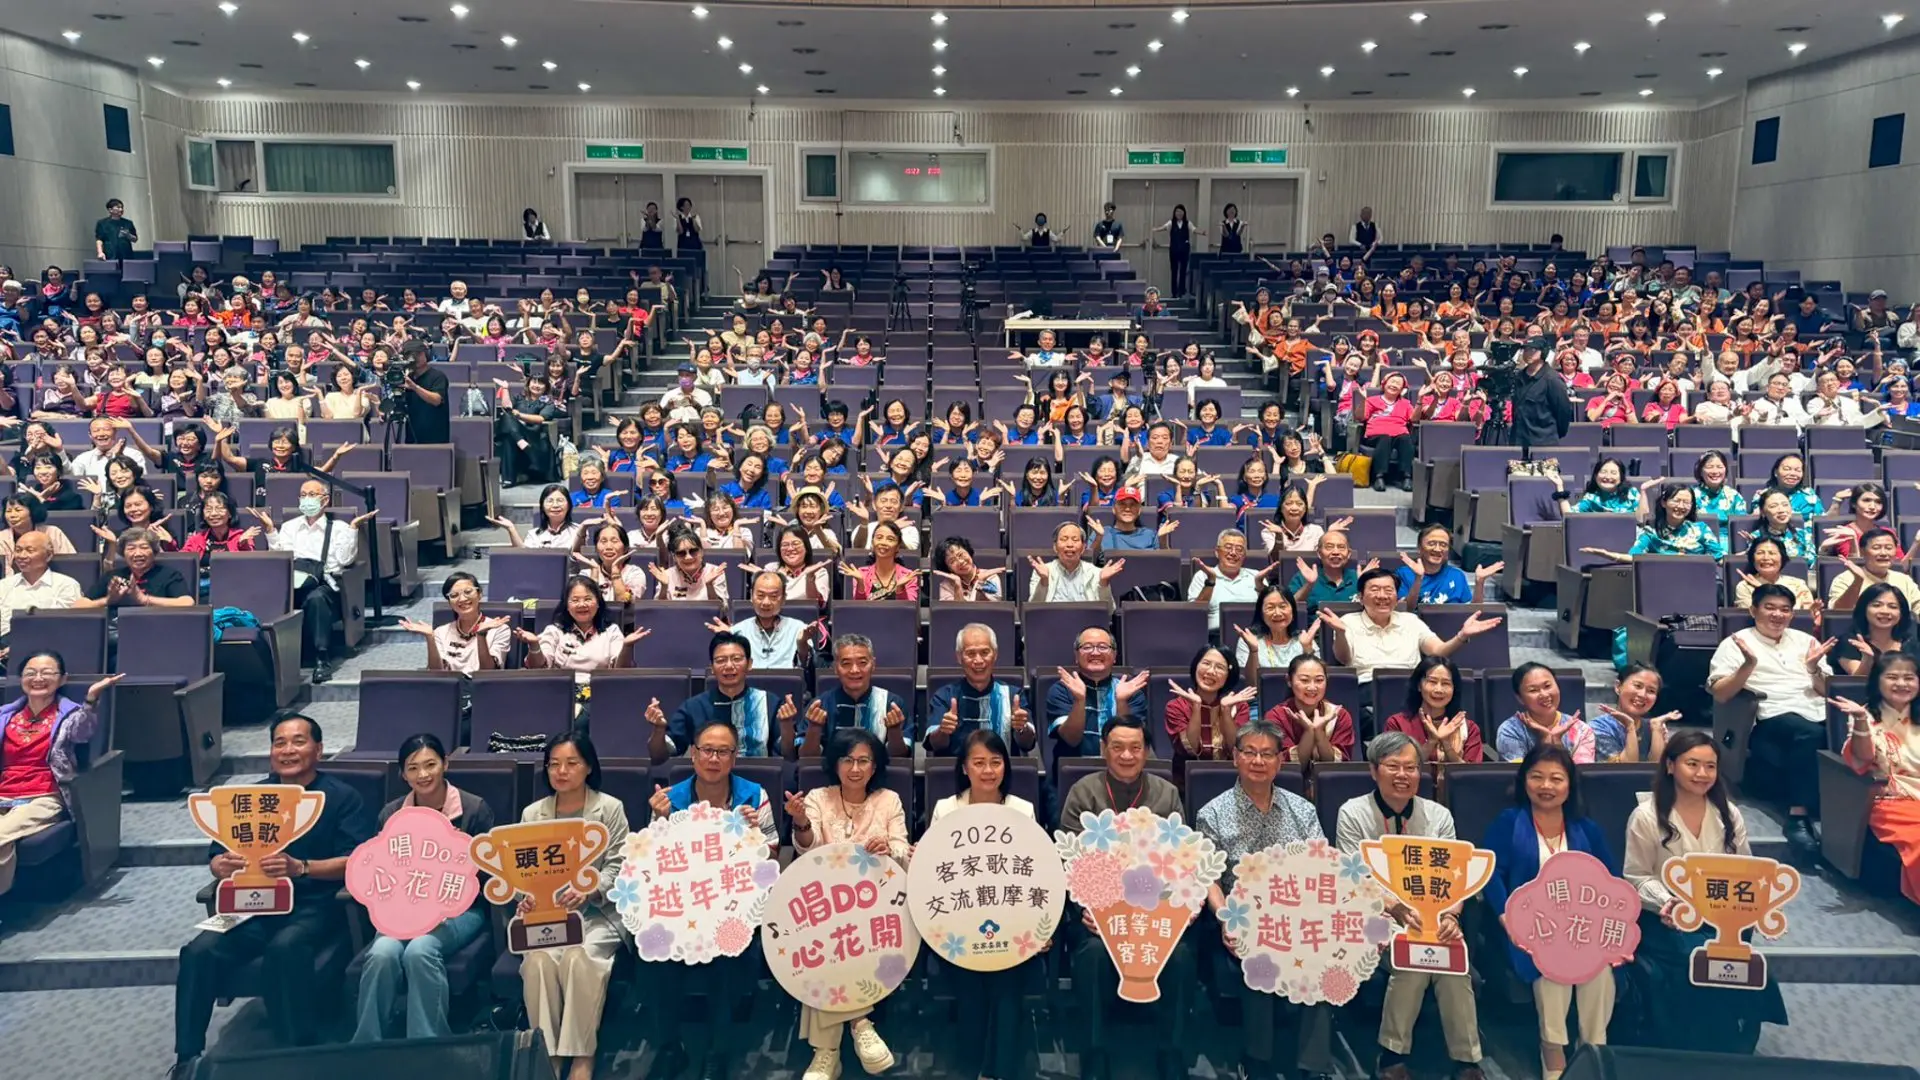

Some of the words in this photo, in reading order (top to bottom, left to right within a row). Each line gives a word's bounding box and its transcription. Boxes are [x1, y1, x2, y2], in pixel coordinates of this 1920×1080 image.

[231, 822, 280, 843] 唱歌
[389, 833, 412, 859] 唱
[421, 840, 451, 862] Do
[951, 825, 1013, 849] 2026
[515, 844, 566, 869] 頭名
[656, 832, 723, 876] 越唱
[936, 853, 1034, 884] 客家歌謠
[367, 867, 466, 903] 心花開
[648, 861, 754, 919] 越年輕
[1268, 873, 1337, 907] 越唱
[1403, 875, 1452, 900] 唱歌
[1546, 879, 1571, 904] 唱
[1580, 885, 1610, 908] Do
[1706, 878, 1755, 903] 頭名
[926, 884, 1049, 920] 交流觀摩賽
[792, 913, 902, 969] 心花開
[1257, 910, 1364, 953] 越年輕
[1529, 911, 1626, 949] 心花開
[1117, 941, 1159, 966] 客家
